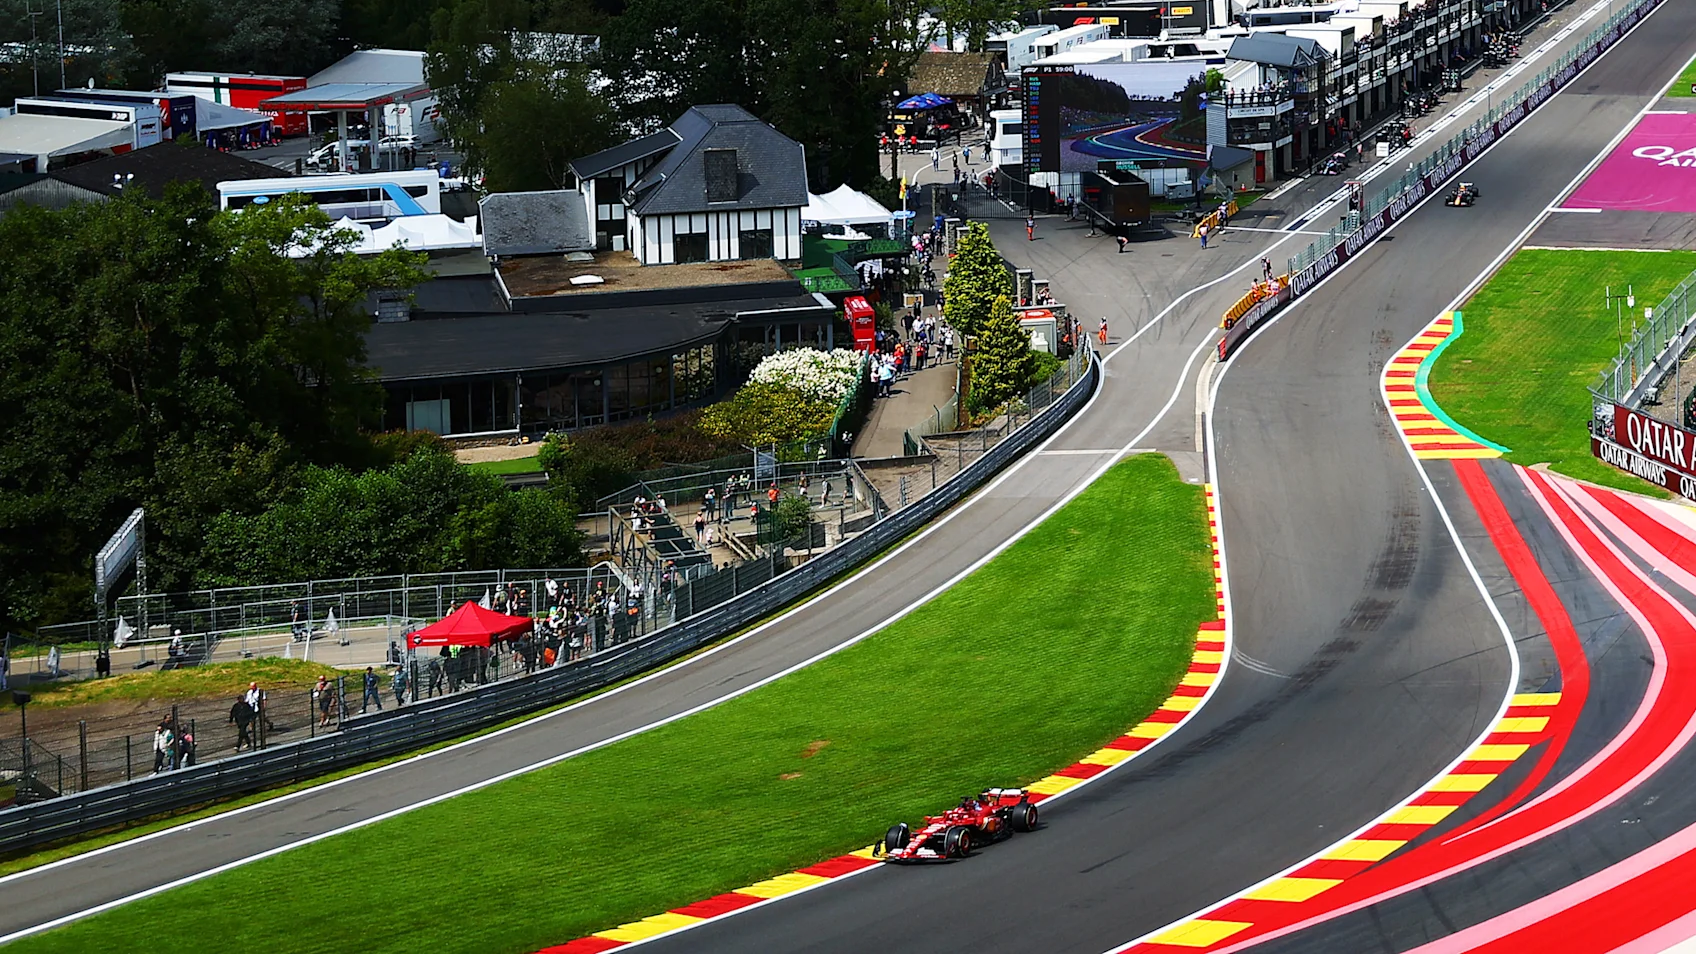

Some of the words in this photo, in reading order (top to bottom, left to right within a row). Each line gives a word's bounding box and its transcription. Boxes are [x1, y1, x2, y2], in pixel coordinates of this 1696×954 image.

[1390, 200, 1407, 221] QATAR
[1407, 180, 1426, 207] AIRWAYS
[1345, 232, 1363, 257] QATAR
[1363, 212, 1385, 242] AIRWAYS
[1293, 270, 1315, 296] QATAR
[1315, 248, 1339, 278] AIRWAYS
[1246, 308, 1259, 330] QATAR
[1259, 296, 1279, 319] AIRWAYS
[1626, 412, 1687, 469] QATAR
[1600, 441, 1628, 473] QATAR
[1628, 453, 1666, 488] AIRWAYS
